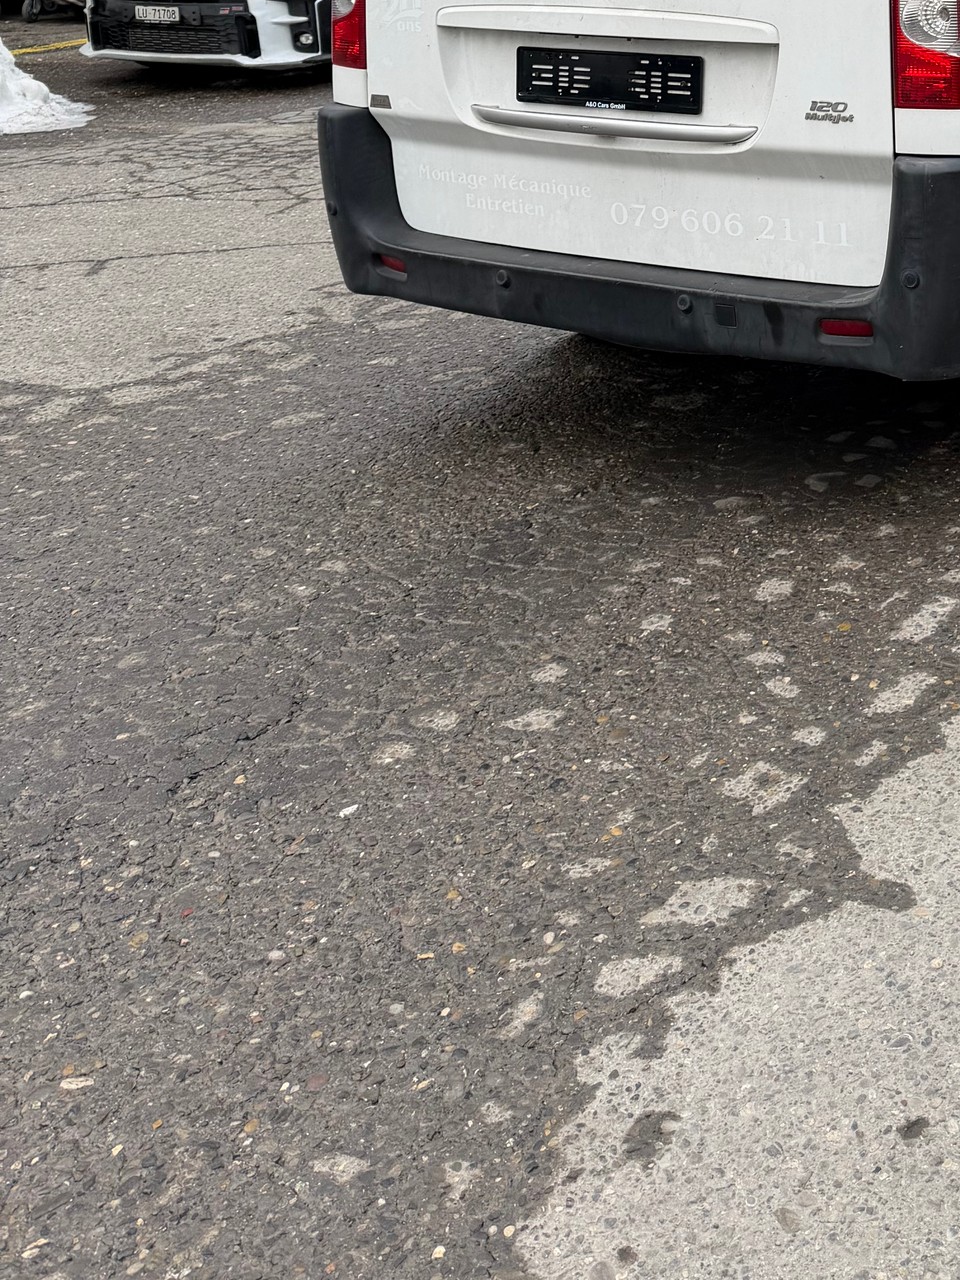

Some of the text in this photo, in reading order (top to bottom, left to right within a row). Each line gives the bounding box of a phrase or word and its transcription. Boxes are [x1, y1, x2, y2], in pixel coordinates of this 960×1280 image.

[809, 100, 849, 113] 120
[418, 164, 592, 200] Montage Mécanique
[465, 193, 545, 217] Entretien
[610, 202, 854, 247] 079 606 21 11
